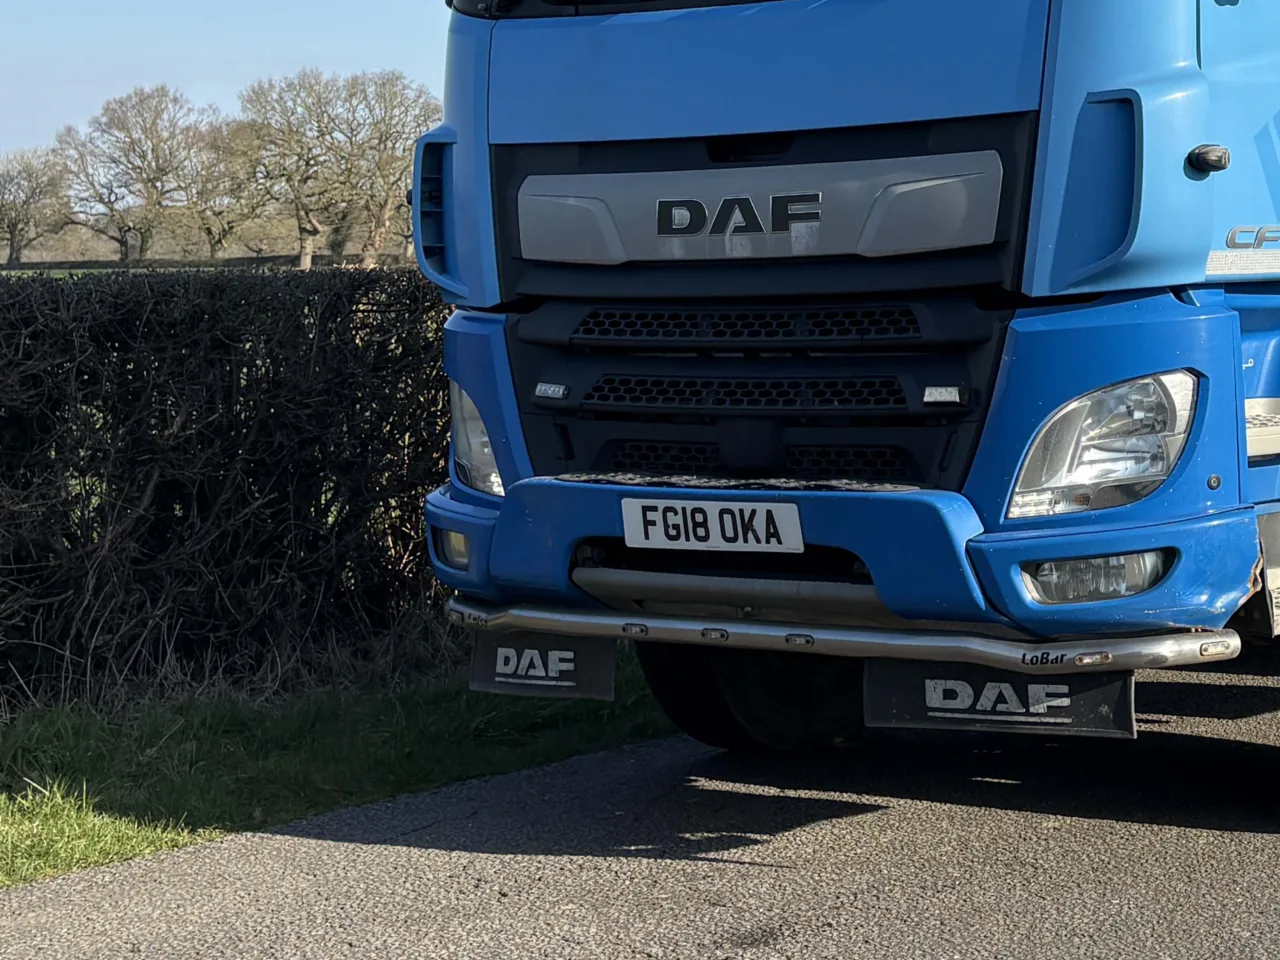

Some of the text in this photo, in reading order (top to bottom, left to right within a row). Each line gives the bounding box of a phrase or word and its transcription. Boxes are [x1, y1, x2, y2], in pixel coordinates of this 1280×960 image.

[656, 192, 822, 237] DAF
[641, 505, 783, 546] FG18 OKA
[495, 647, 575, 677] DAF
[1021, 651, 1068, 666] LoBar
[925, 678, 1071, 714] DAF
